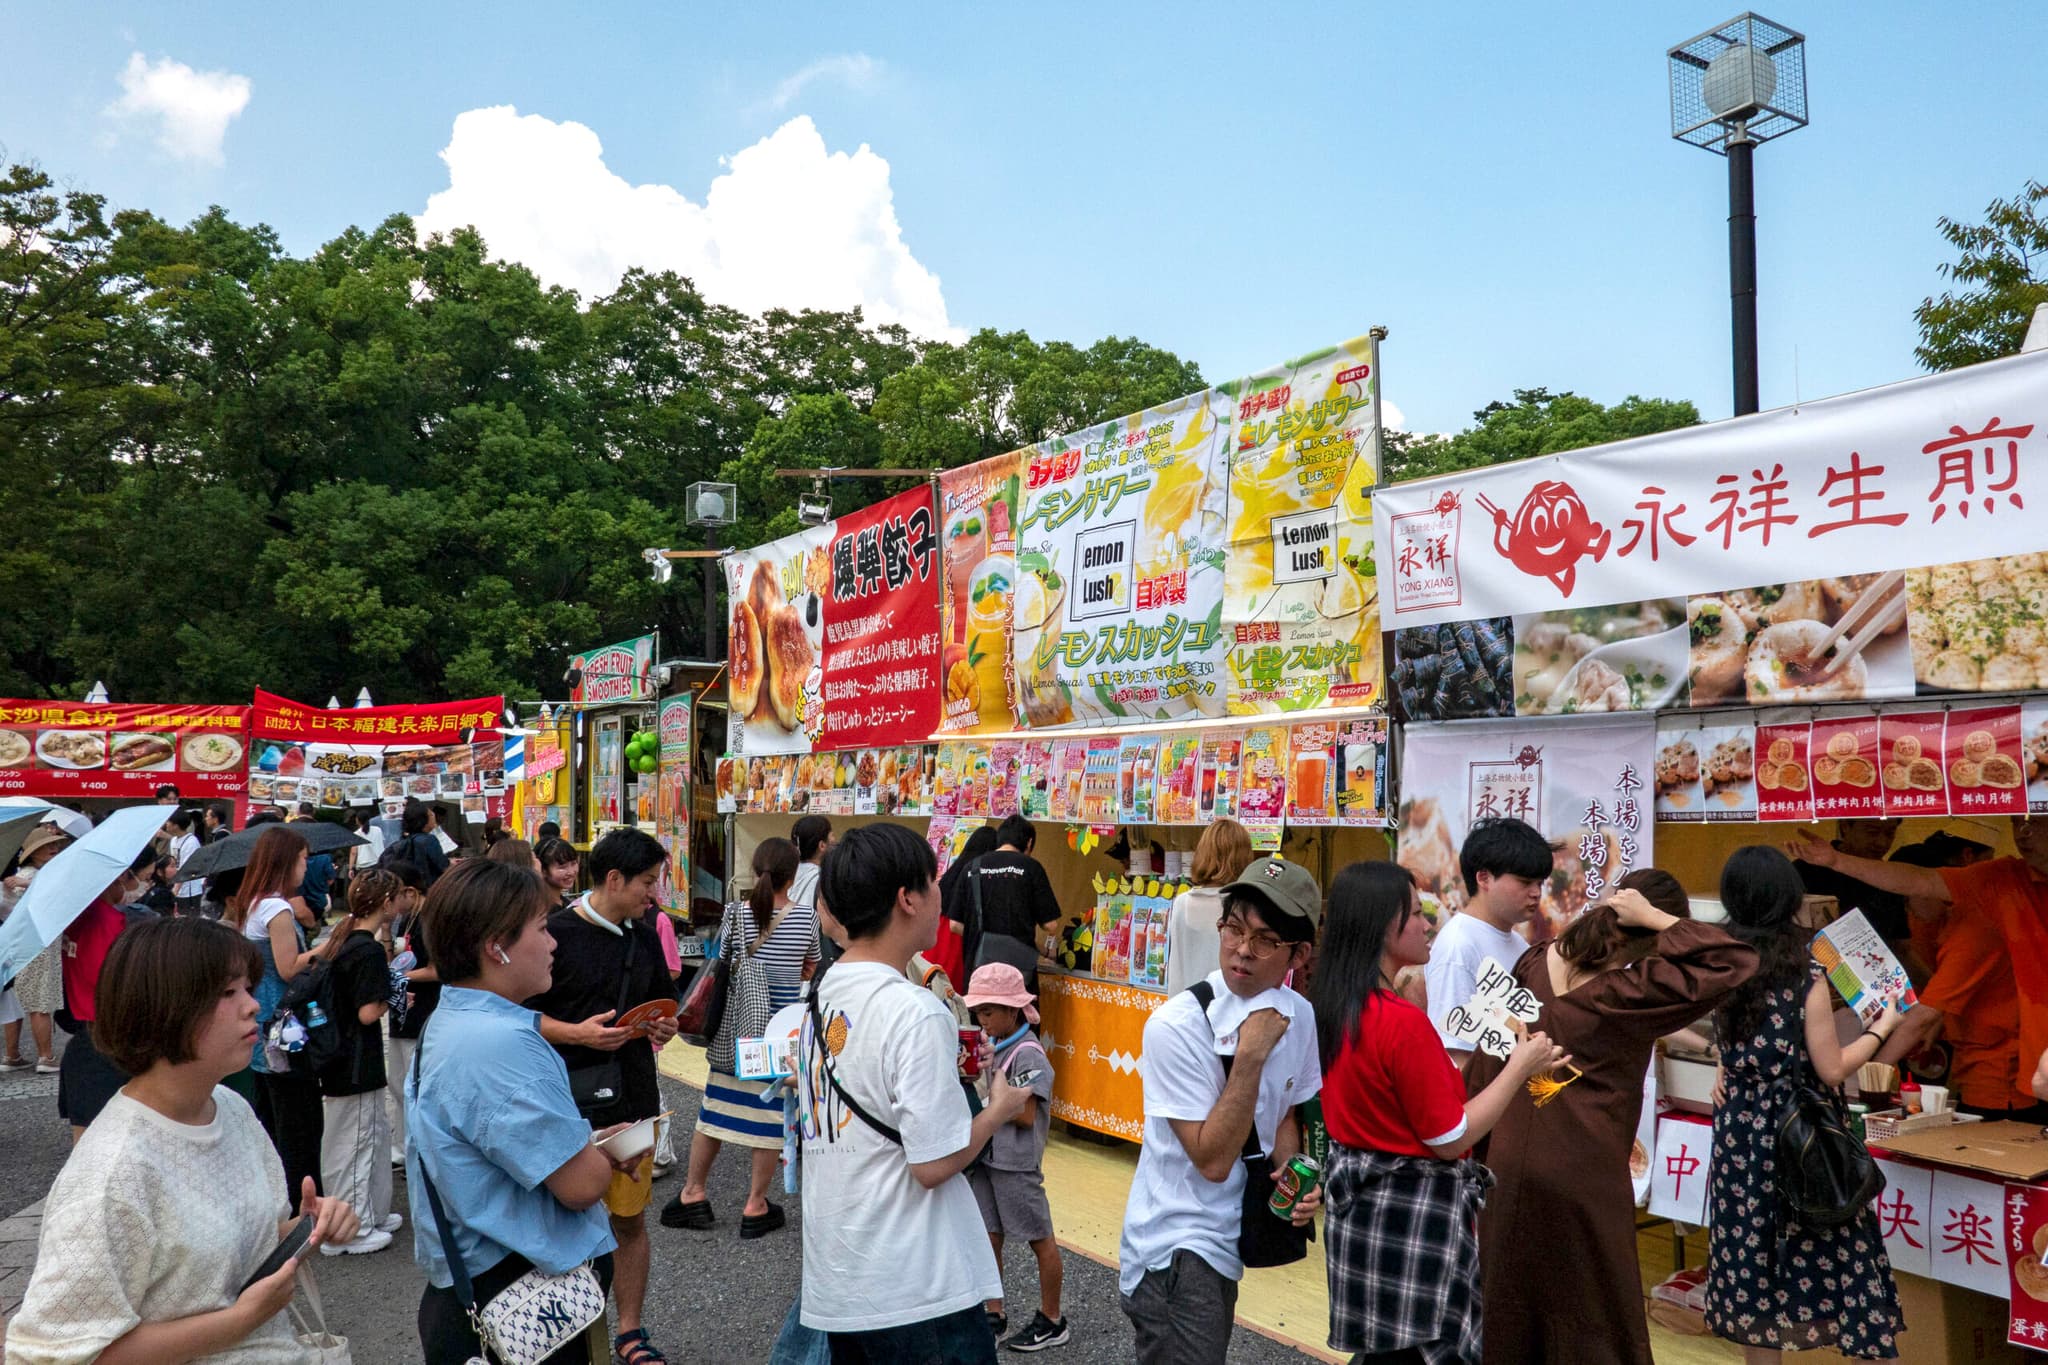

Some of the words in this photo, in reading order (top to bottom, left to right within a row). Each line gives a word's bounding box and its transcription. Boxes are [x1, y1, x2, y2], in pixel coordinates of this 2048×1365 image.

[1239, 384, 1292, 422] ガチ盛り
[1238, 395, 1370, 451] 生レモンサワー
[944, 476, 984, 513] Tropical
[1617, 416, 2035, 562] 永祥生煎
[1284, 521, 1329, 547] Lemon
[831, 505, 937, 604] 爆弾餃子
[1292, 548, 1324, 571] Lush
[1398, 533, 1452, 578] 永祥
[1136, 570, 1188, 612] 自家製
[1400, 580, 1422, 593] YONG
[1424, 576, 1454, 590] XIANG
[826, 610, 895, 644] 鹿児島黒豚肉使って
[1037, 612, 1213, 671] レモンスカッシュ
[1234, 622, 1282, 645] 自家製
[610, 651, 634, 674] FRUIT
[1237, 639, 1362, 674] レモンスカッシュ
[587, 677, 632, 702] SMOOTHIES
[265, 715, 305, 732] 団法人
[81, 781, 107, 790] ¥400
[1892, 793, 1936, 808] 鮮肉月餅
[1962, 792, 2014, 806] 鮮肉月餅
[1476, 787, 1535, 820] 永祥
[1815, 794, 1884, 811] 蛋黄鮮肉月餅
[1666, 1144, 1701, 1201] 中
